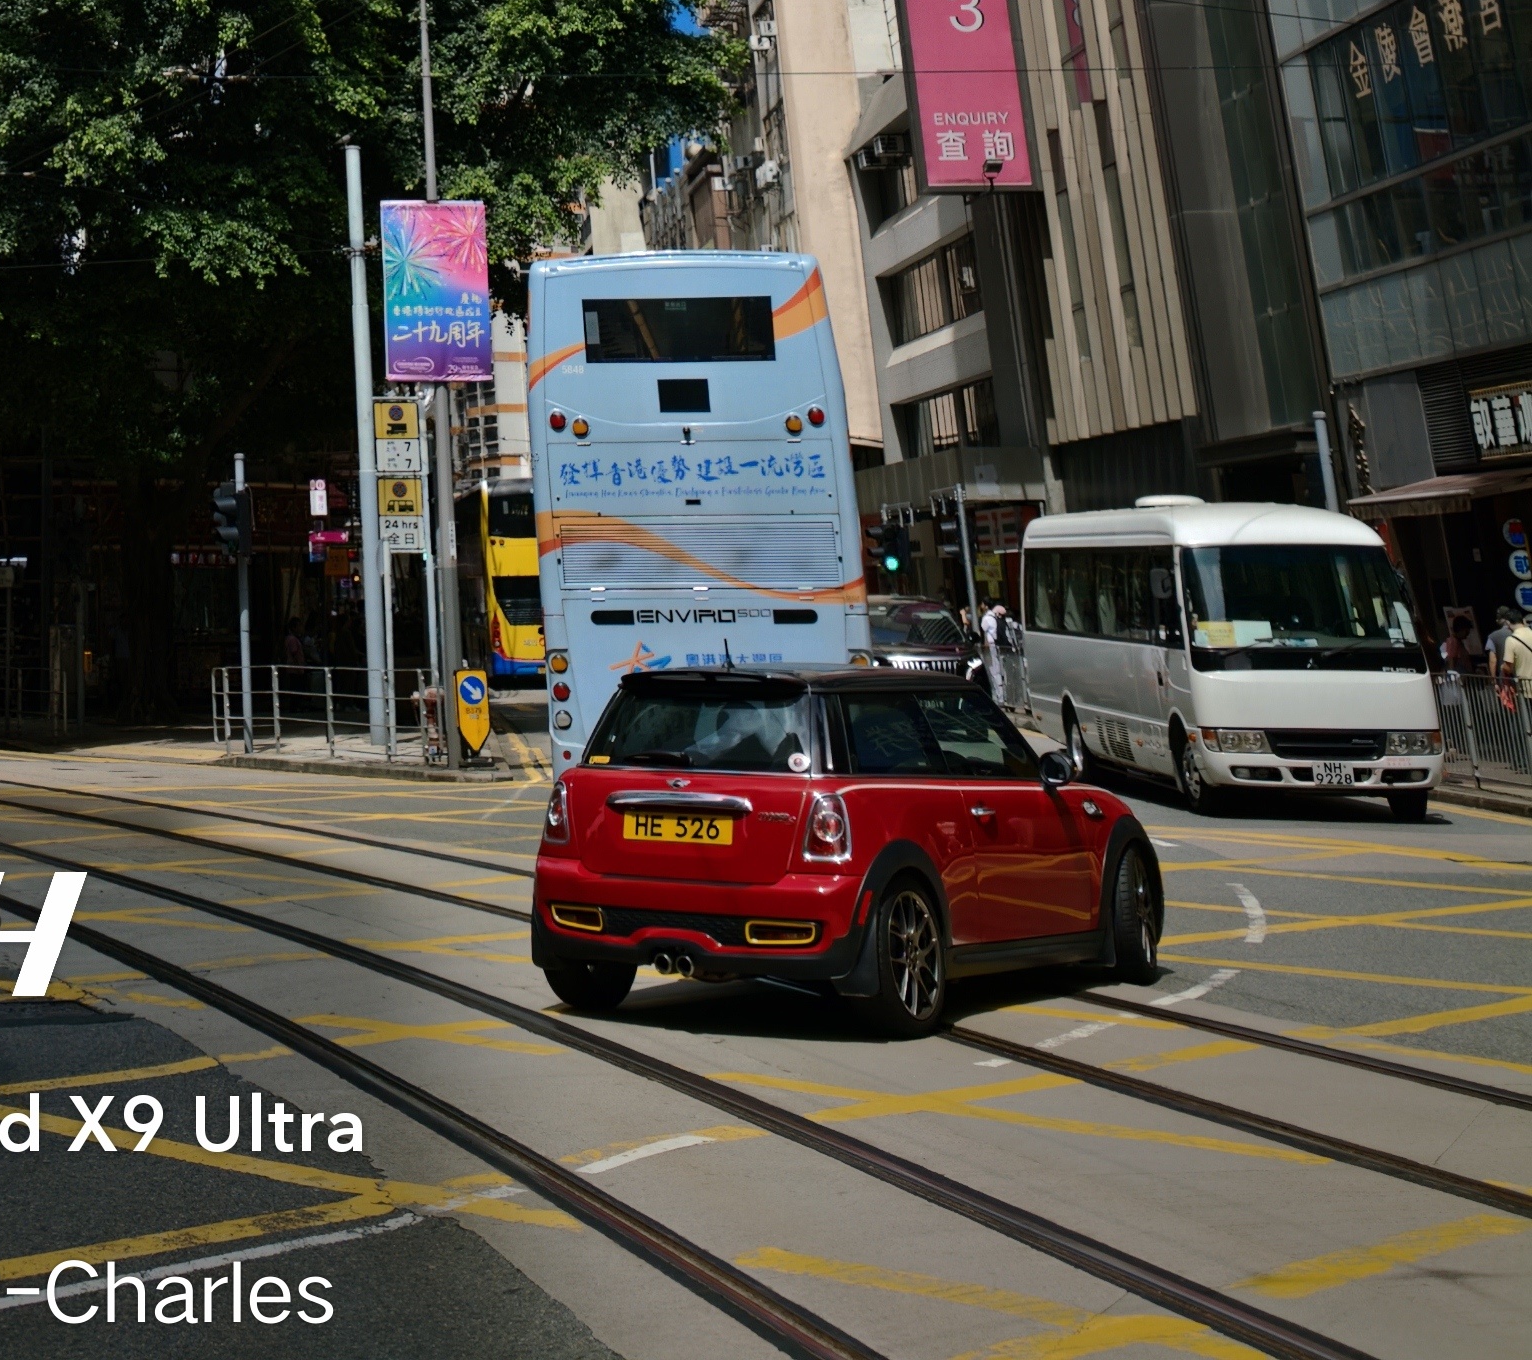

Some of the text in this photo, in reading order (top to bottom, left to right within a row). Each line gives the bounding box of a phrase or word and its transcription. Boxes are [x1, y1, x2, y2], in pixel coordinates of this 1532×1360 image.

[933, 110, 1010, 126] ENQUIRY
[935, 129, 1017, 163] 查詢
[392, 320, 486, 348] 二十九周年
[404, 442, 411, 452] 7
[405, 459, 412, 469] 7
[384, 519, 419, 530] 24 hrs
[388, 532, 415, 546] 全日
[1324, 762, 1343, 774] NH
[1316, 772, 1353, 785] 9228
[635, 814, 720, 841] HE 526
